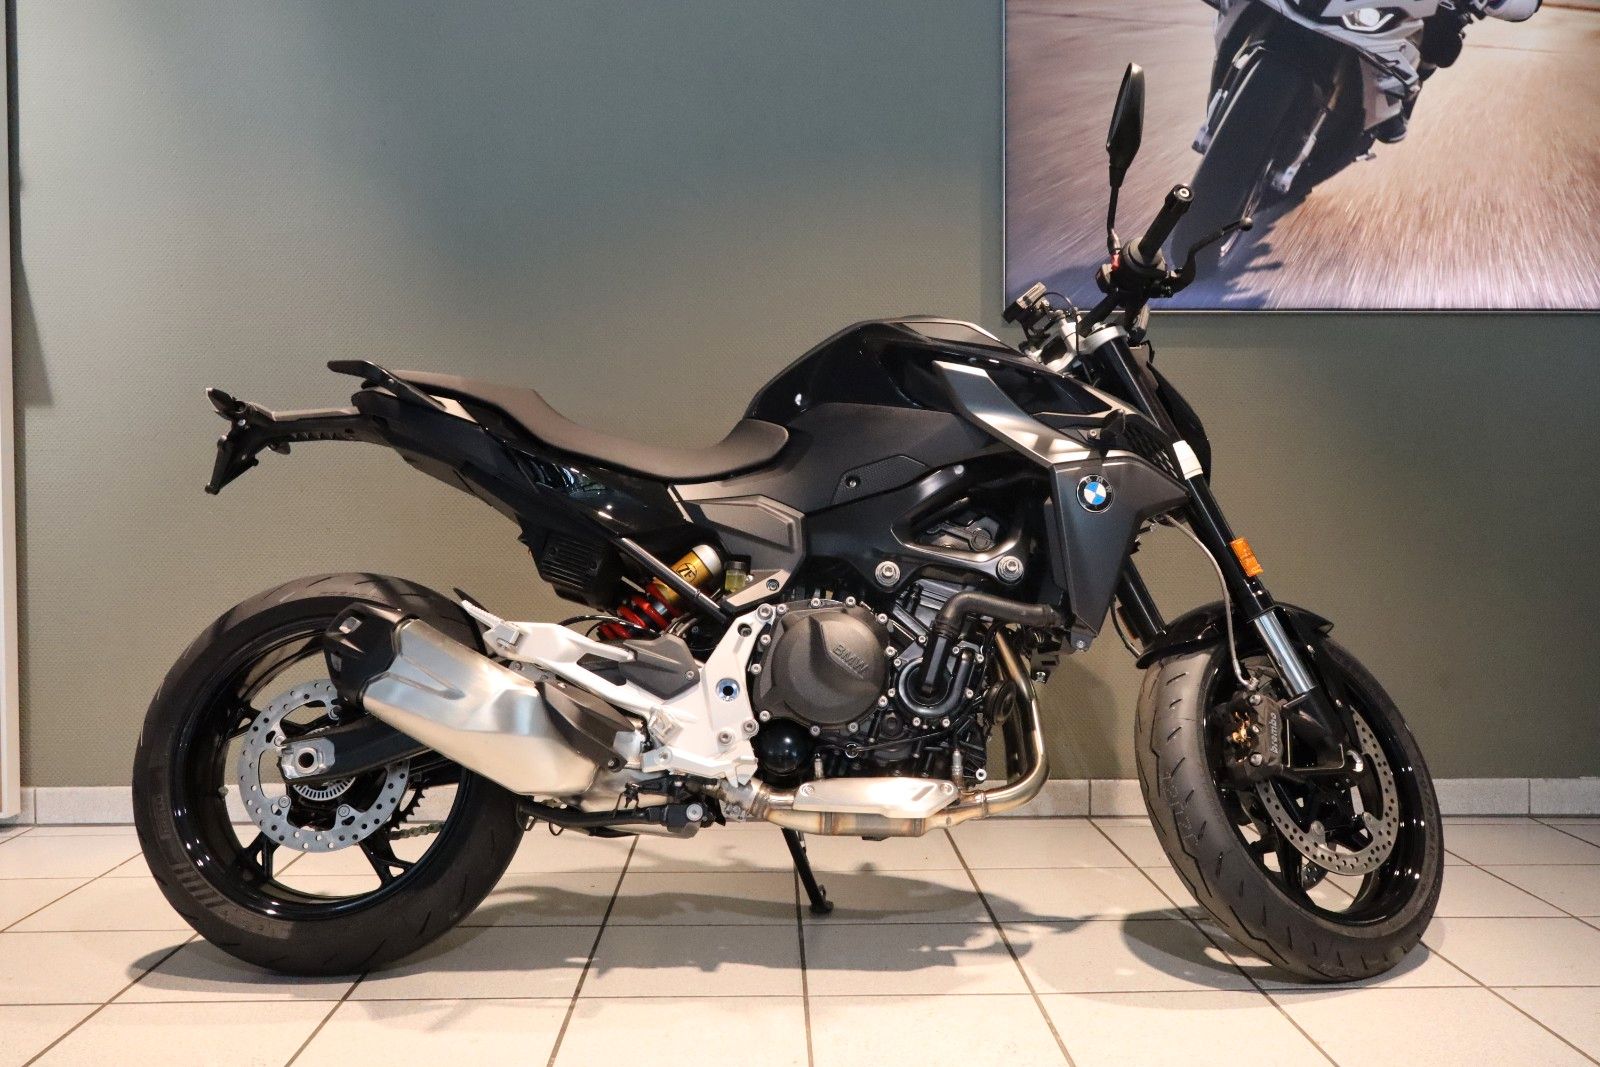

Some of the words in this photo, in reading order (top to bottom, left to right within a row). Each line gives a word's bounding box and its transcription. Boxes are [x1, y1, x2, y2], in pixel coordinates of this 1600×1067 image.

[1085, 475, 1113, 493] BMW
[677, 563, 697, 582] ZF
[832, 644, 869, 674] BMW
[1269, 712, 1279, 754] brembo
